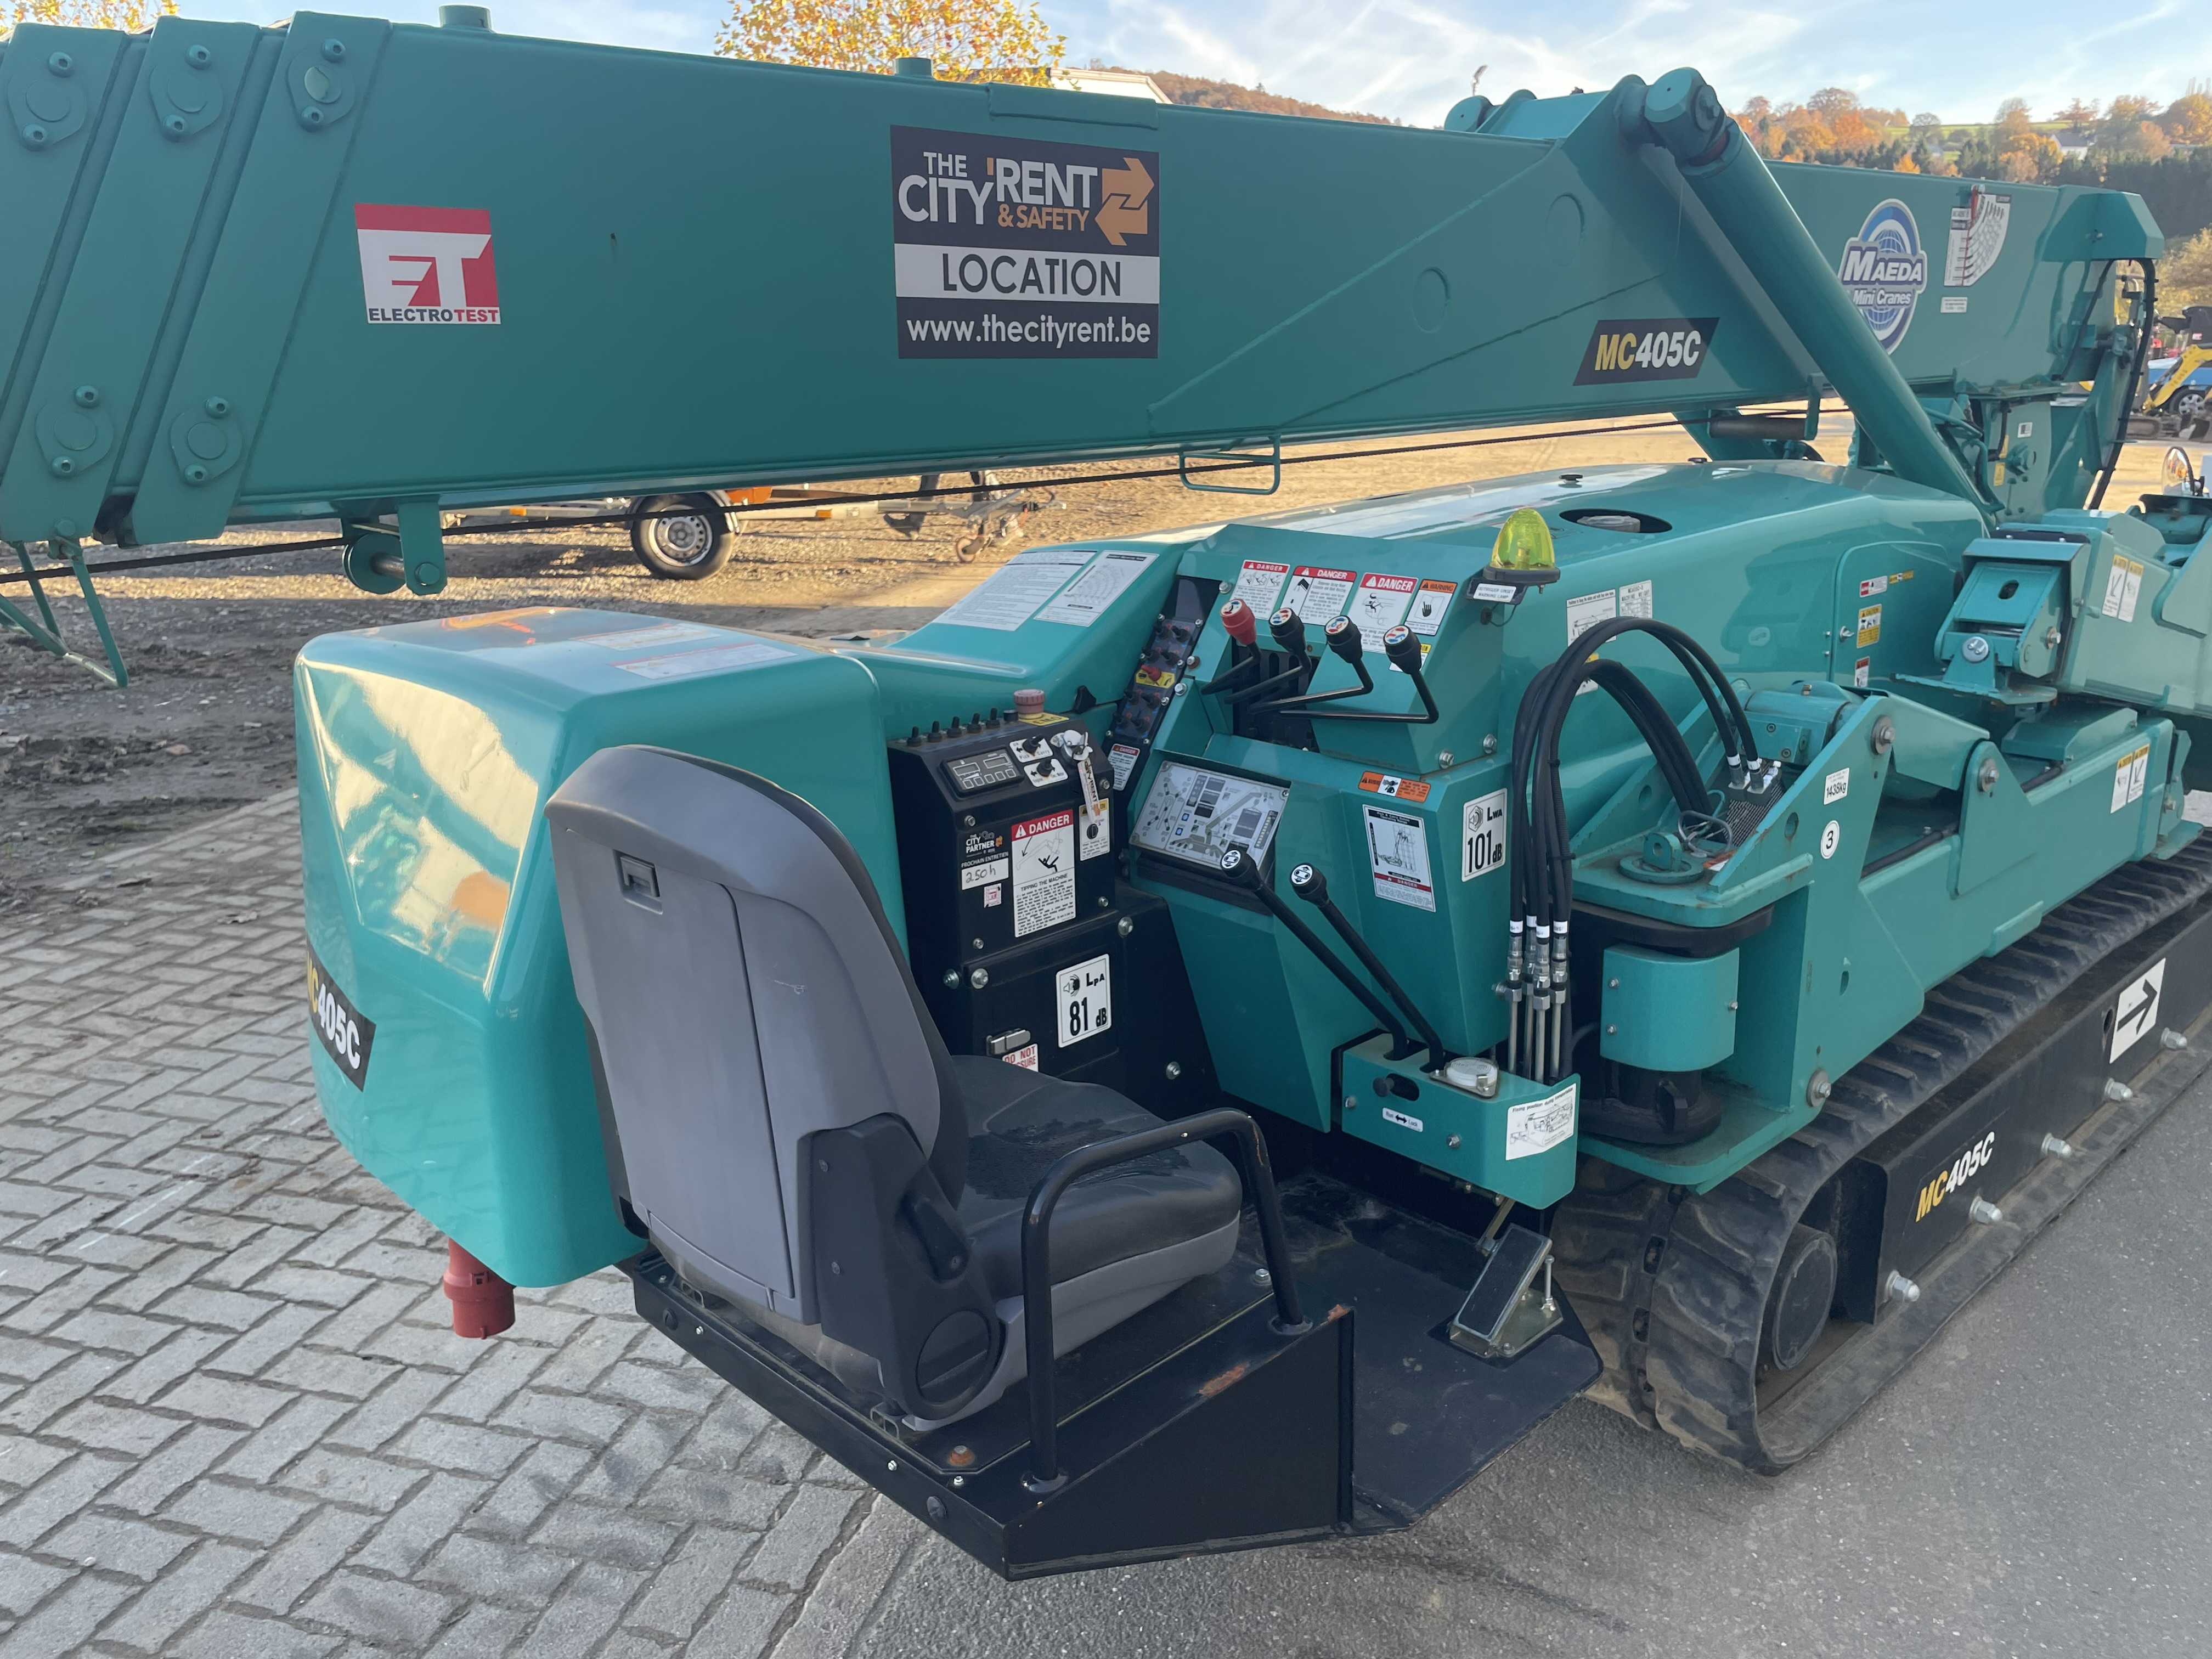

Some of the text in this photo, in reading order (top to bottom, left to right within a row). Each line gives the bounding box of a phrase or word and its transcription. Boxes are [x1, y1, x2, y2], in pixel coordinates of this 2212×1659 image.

[923, 151, 967, 178] THE
[898, 174, 994, 225] CITY
[998, 204, 1090, 231] & SAFETY
[942, 253, 1121, 296] LOCATION
[1843, 250, 1922, 281] MAEDA
[1853, 289, 1911, 306] Mini Cranes
[368, 308, 499, 322] ELECTROTEST
[907, 314, 1151, 349] www.thecityrent.be
[1595, 330, 1701, 370] MC405C
[1317, 569, 1347, 579] DANGER
[1377, 578, 1413, 591] DANGER
[1430, 583, 1454, 592] WARNING
[1029, 815, 1070, 834] DANGER
[966, 837, 980, 846] CITY
[966, 840, 995, 854] PARTNER
[1826, 830, 1833, 849] 3
[1468, 830, 1502, 873] 101 dB
[961, 857, 985, 868] PROCHAIN
[1070, 997, 1107, 1036] 81 dB
[1005, 1045, 1036, 1063] DO NOT
[1915, 1131, 1995, 1222] MC405C
